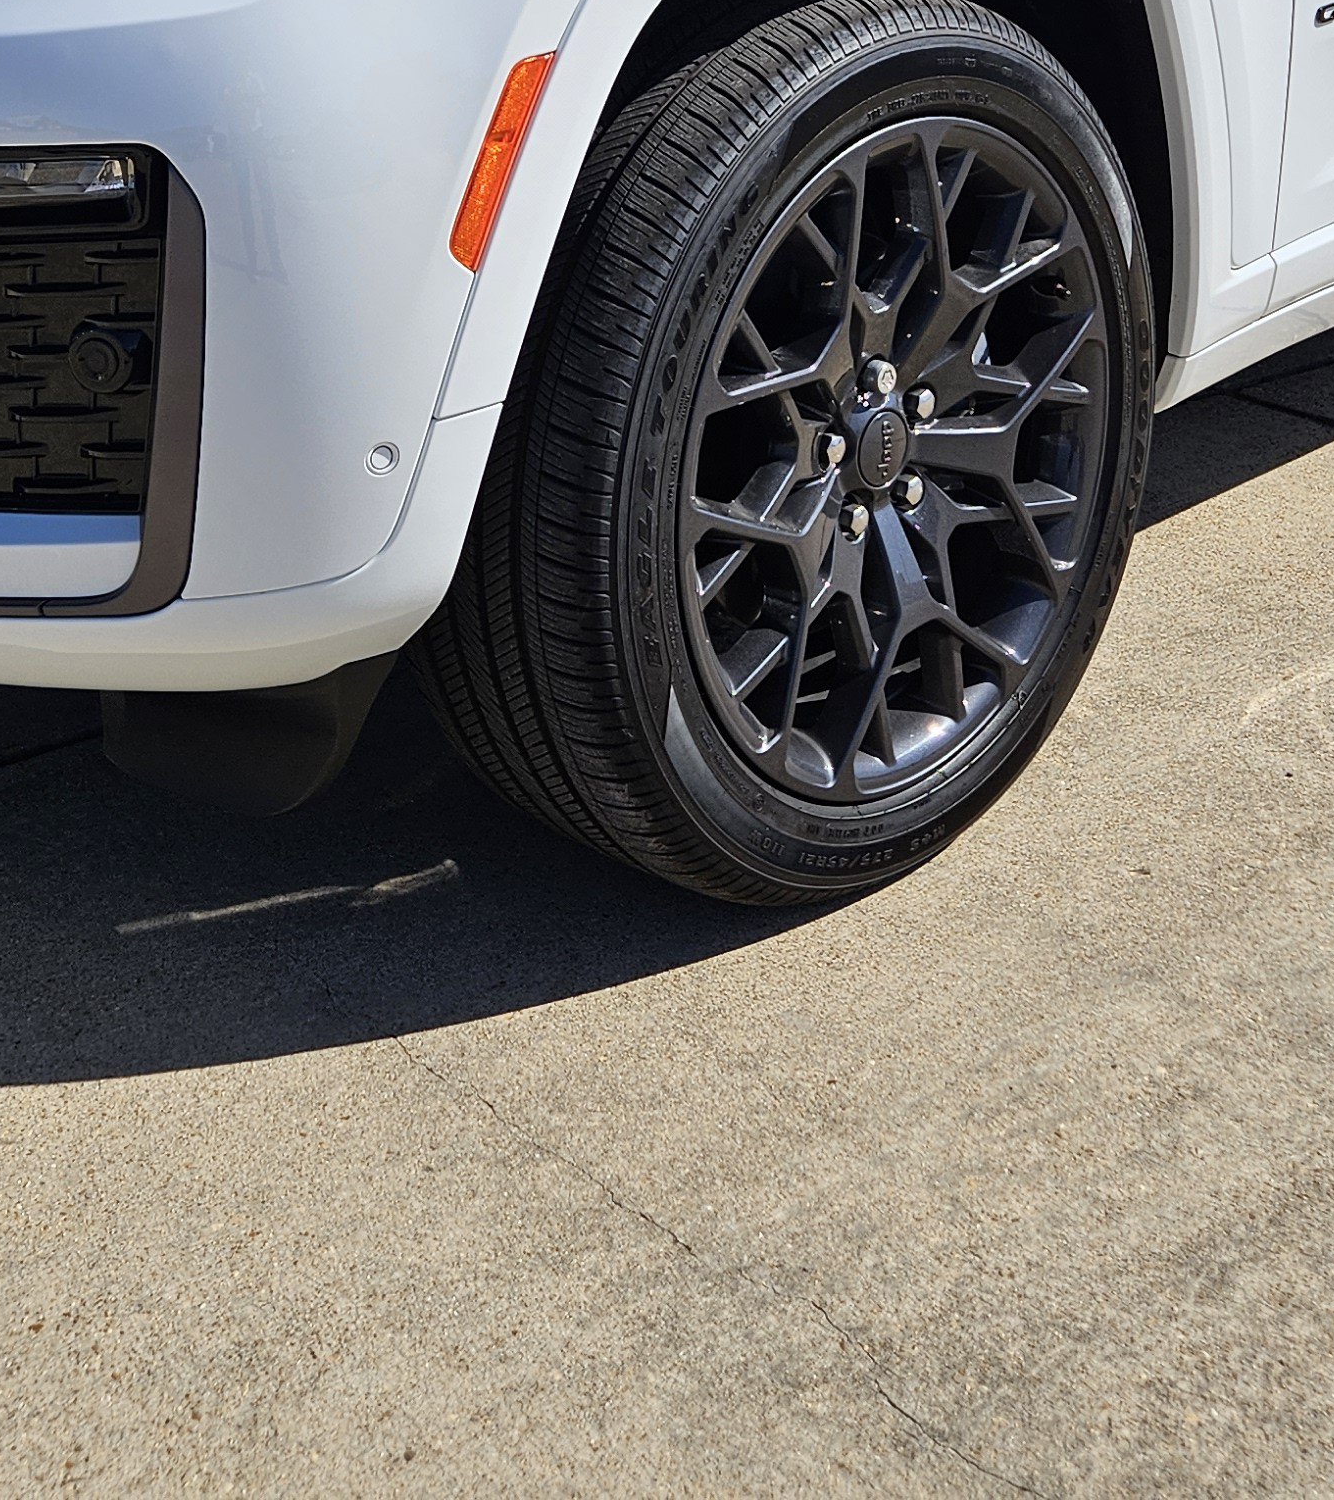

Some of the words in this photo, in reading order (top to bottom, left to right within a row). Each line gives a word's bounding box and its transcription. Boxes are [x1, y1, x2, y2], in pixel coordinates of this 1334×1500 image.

[635, 456, 664, 668] EAGLE
[650, 181, 759, 438] TOURING
[798, 848, 894, 870] 275/45R21
